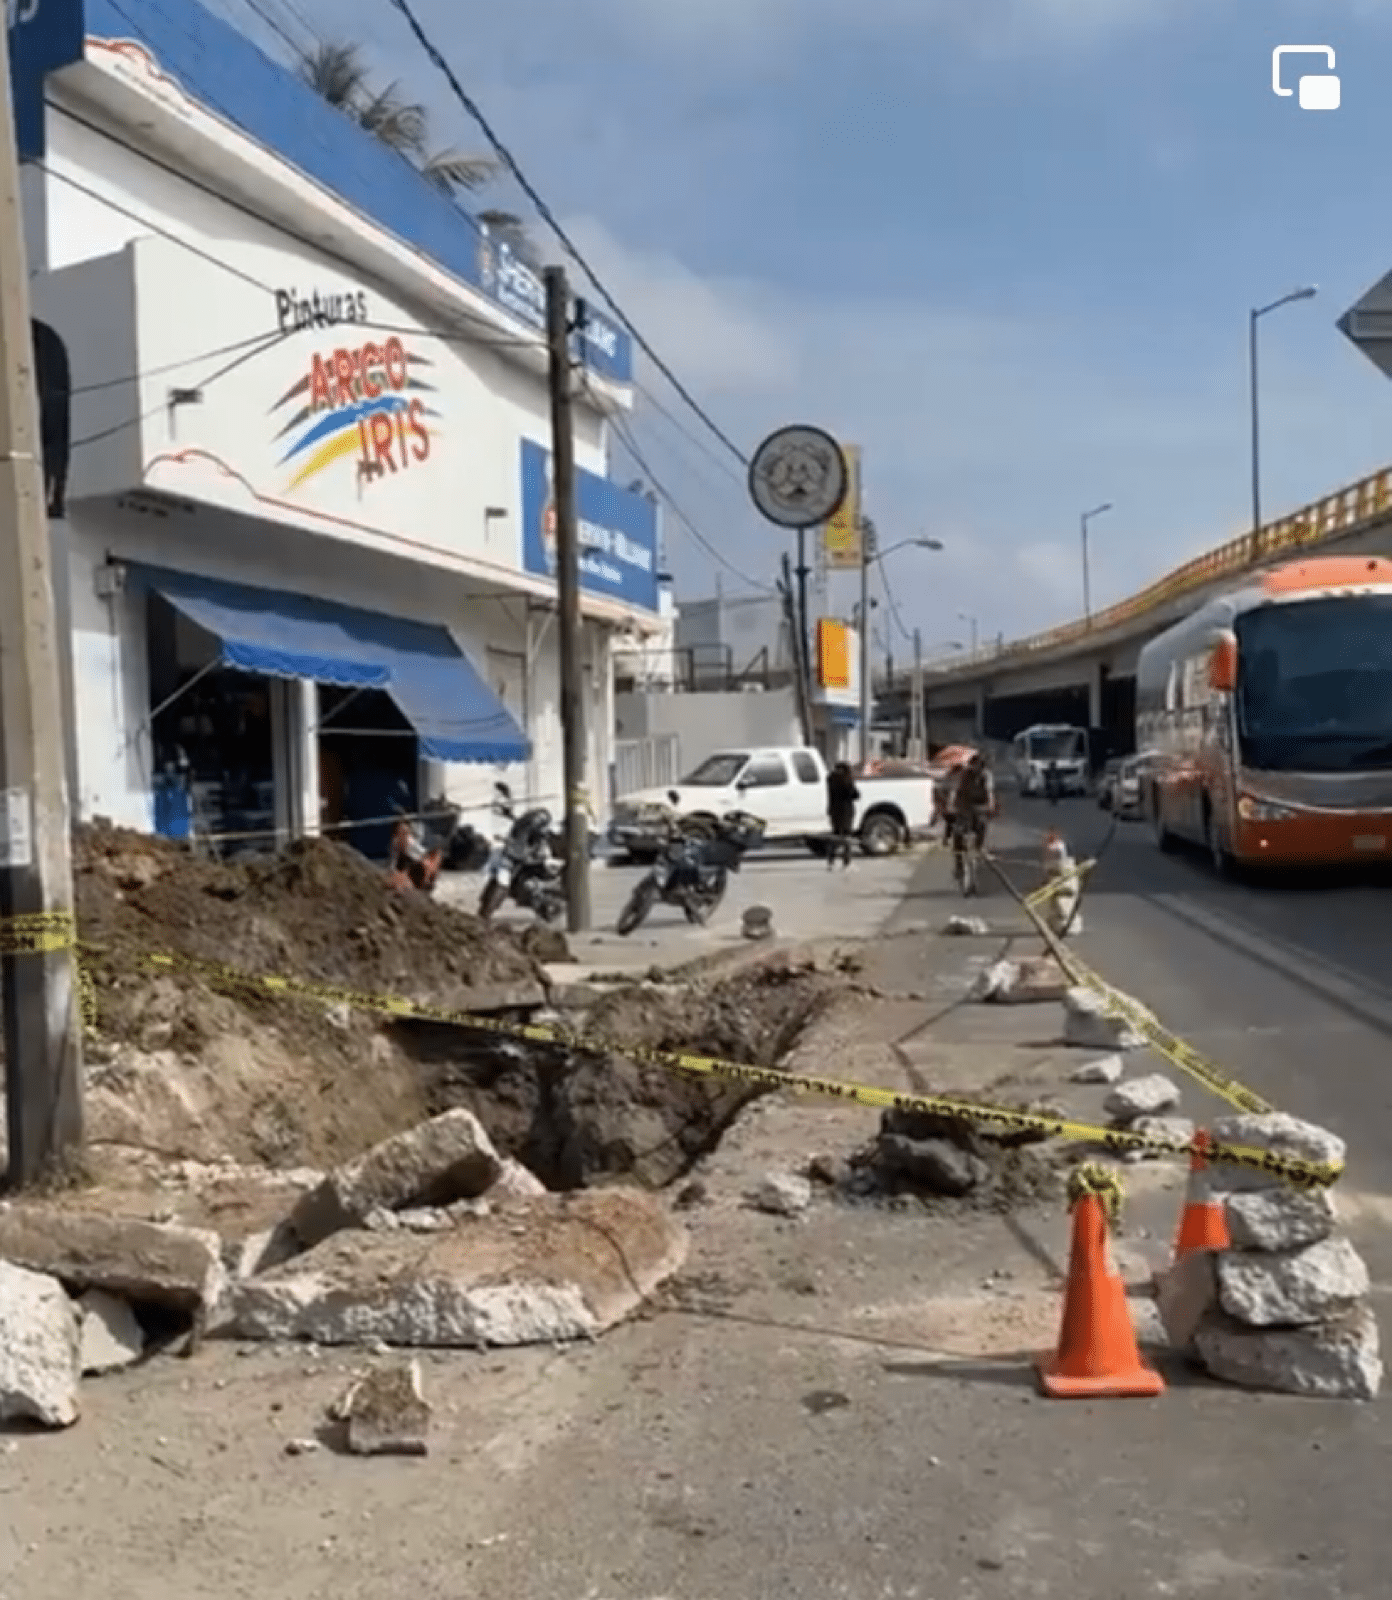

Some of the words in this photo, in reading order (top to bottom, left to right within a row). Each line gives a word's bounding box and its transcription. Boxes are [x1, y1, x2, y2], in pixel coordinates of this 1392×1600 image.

[275, 286, 367, 334] Pinturas
[311, 335, 407, 412] ARCO
[357, 397, 430, 474] IRIS
